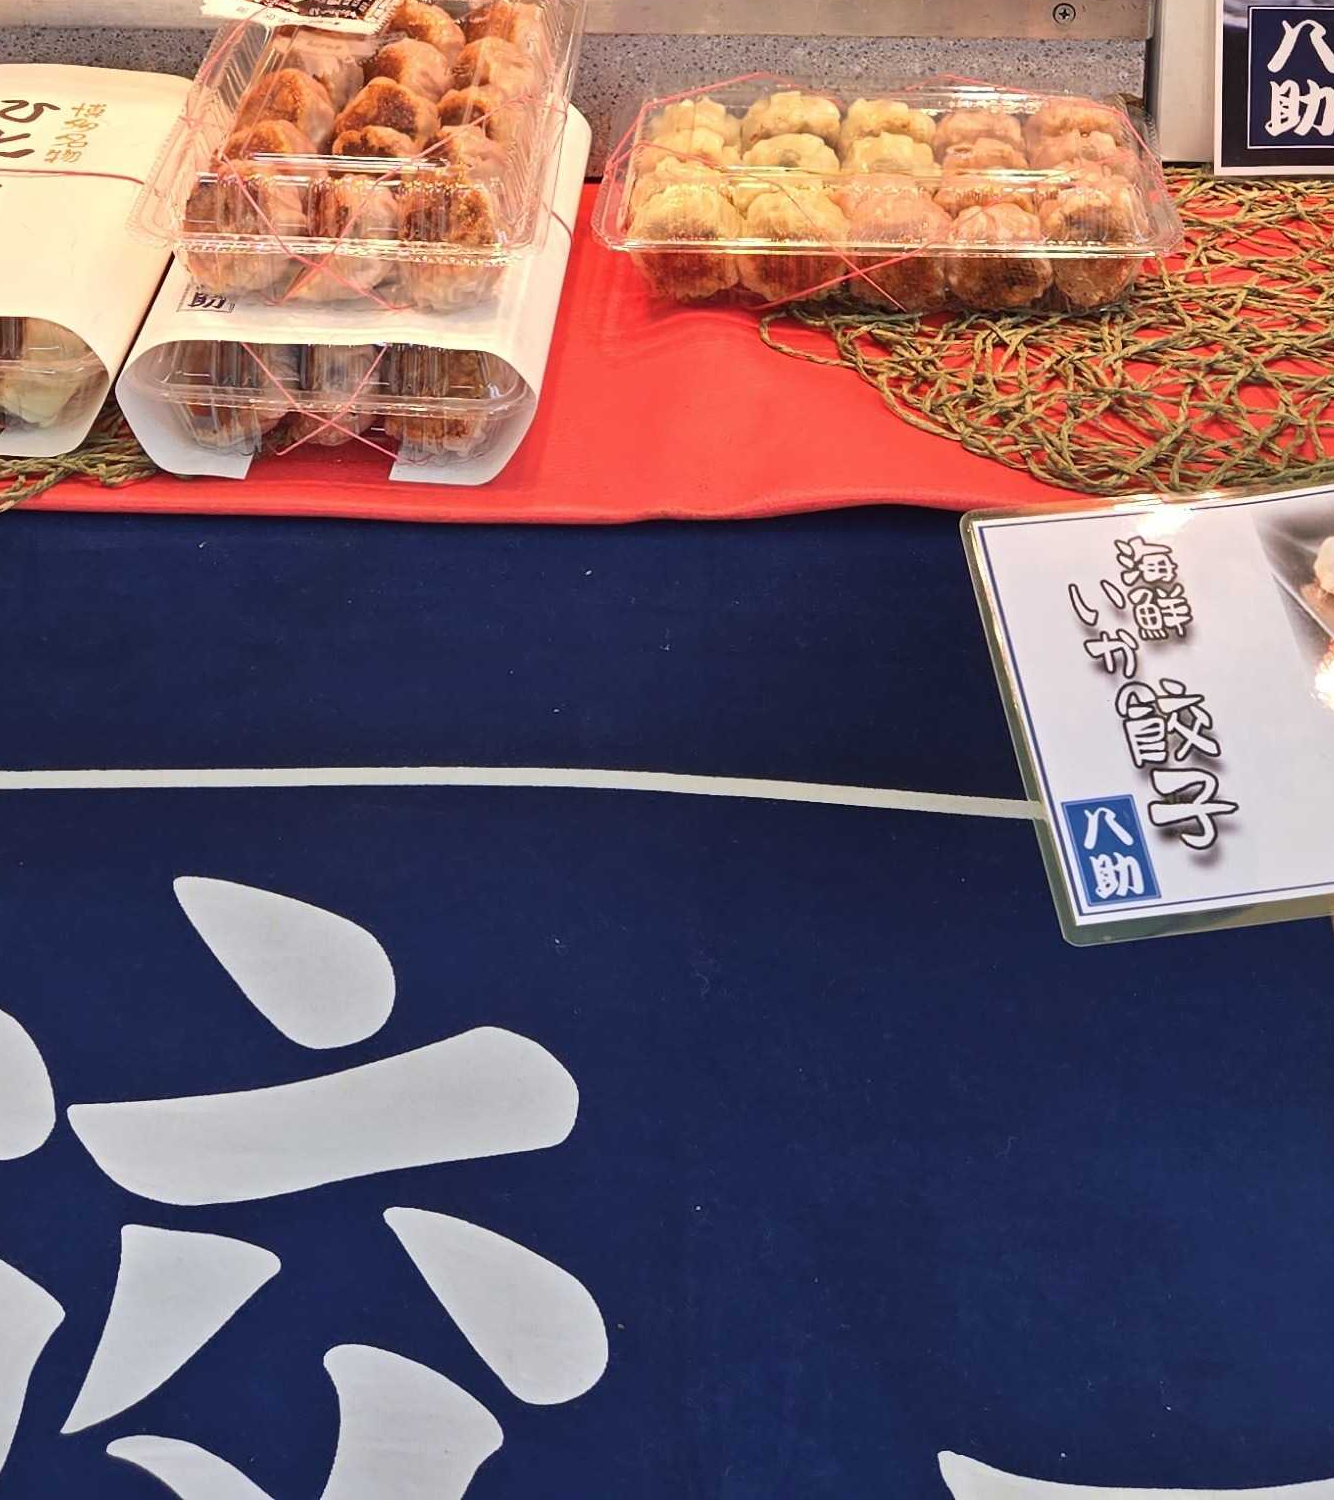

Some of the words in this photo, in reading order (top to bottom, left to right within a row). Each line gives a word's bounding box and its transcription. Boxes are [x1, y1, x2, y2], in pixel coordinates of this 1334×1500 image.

[43, 102, 107, 164] 博多名物
[1083, 806, 1145, 899] 八助
